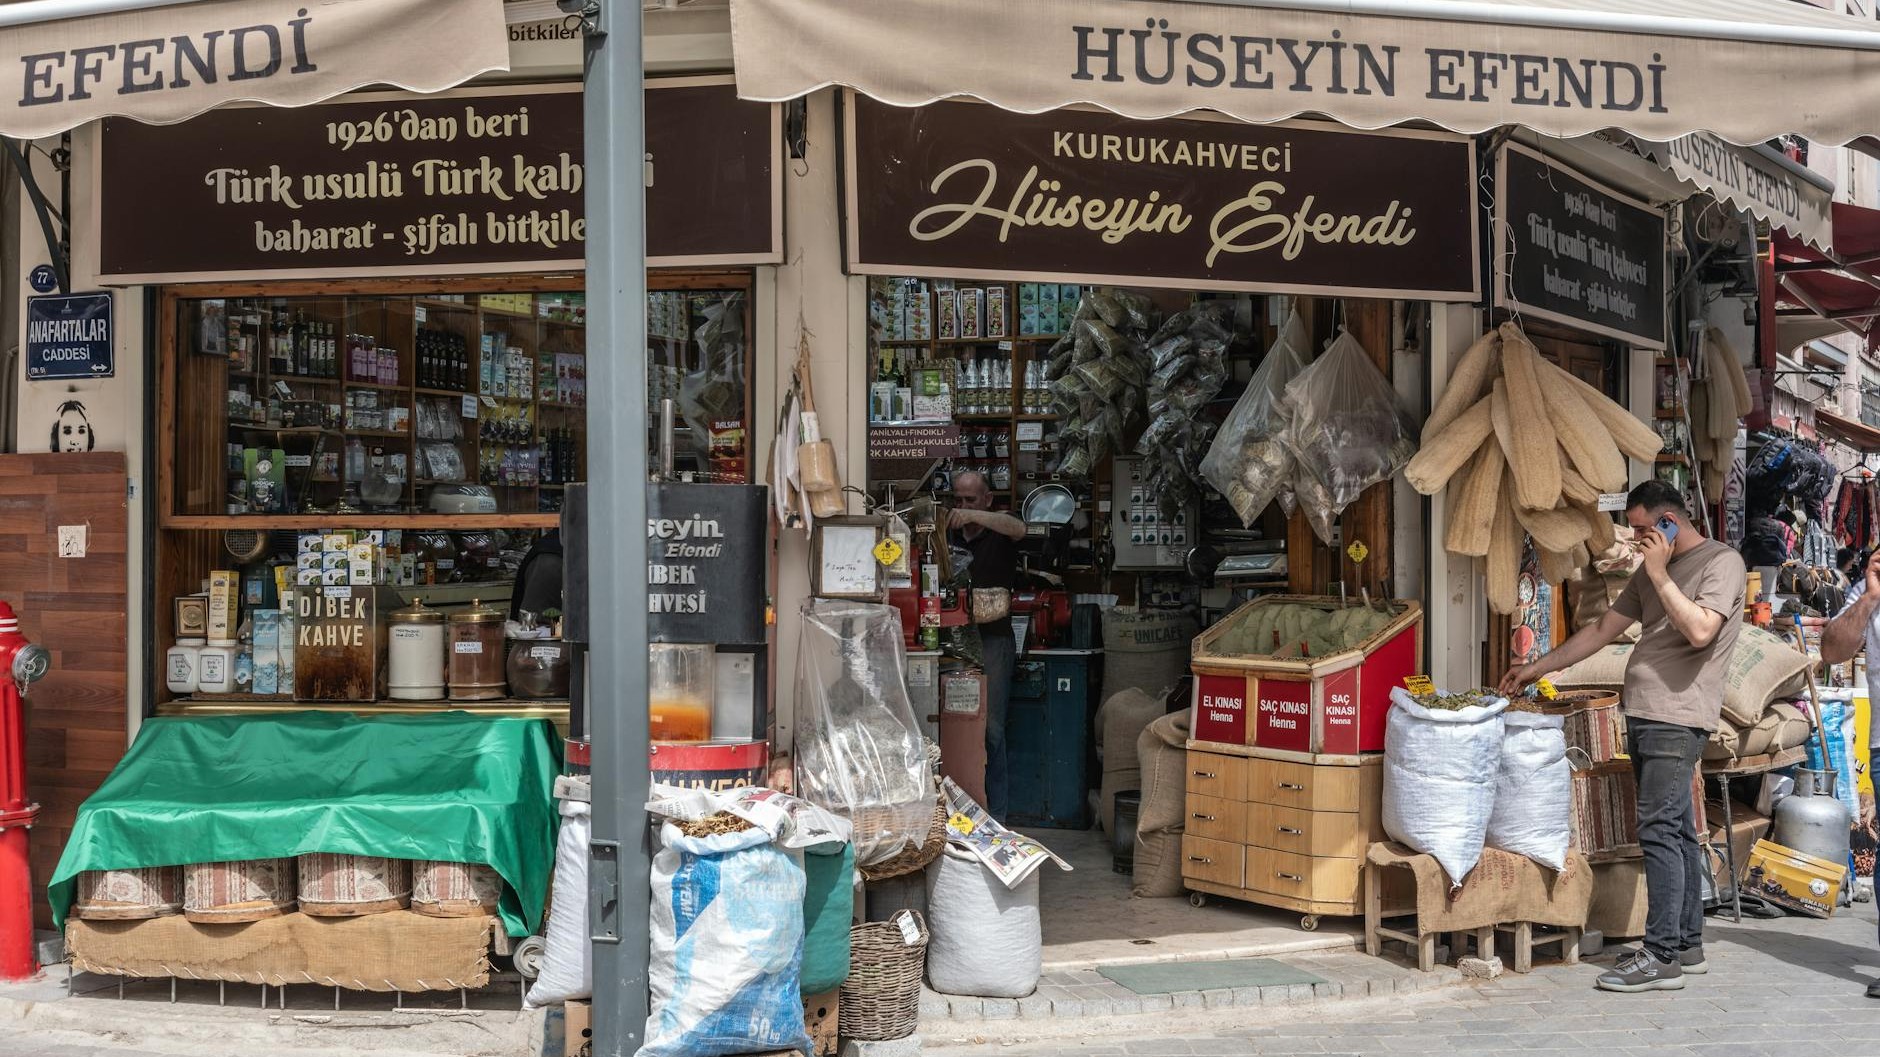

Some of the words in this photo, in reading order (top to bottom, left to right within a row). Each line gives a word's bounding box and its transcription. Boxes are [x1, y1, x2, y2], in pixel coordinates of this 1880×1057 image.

[509, 24, 579, 41] bitkiler
[18, 8, 318, 107] EFENDİ
[1071, 18, 1401, 97] HÜSEYİN
[1425, 47, 1668, 114] EFENDİ
[326, 111, 458, 150] 1926'dan
[466, 107, 529, 138] beri
[1054, 131, 1292, 173] KURUKAHVECİ
[205, 168, 303, 209] Türk
[303, 161, 403, 201] usulü
[412, 158, 514, 201] Türk
[909, 158, 1193, 246] Hüseyin
[1206, 180, 1416, 268] Efendi
[255, 221, 376, 254] baharat
[402, 214, 478, 256] şifalı
[487, 209, 585, 249] bitkile
[37, 272, 48, 284] 77
[29, 318, 107, 343] ANAFARTALAR
[42, 344, 90, 361] CADDESİ
[884, 447, 926, 457] KAHVESİ
[648, 513, 723, 540] seyin
[665, 543, 722, 558] Efendi
[648, 561, 696, 585] İBEK
[300, 587, 366, 619] DİBEK
[300, 625, 363, 647] KAHVE
[1203, 695, 1214, 707] EL
[1215, 696, 1242, 710] KINASI
[1260, 699, 1278, 713] SAÇ
[1279, 702, 1308, 715] KINASI
[1326, 706, 1355, 715] KINASI
[1331, 694, 1350, 706] SAÇ
[1210, 710, 1233, 723] Henna
[1269, 715, 1296, 729] Henna
[1329, 717, 1351, 725] Henna
[748, 1016, 769, 1039] 50
[770, 1031, 780, 1042] kg
